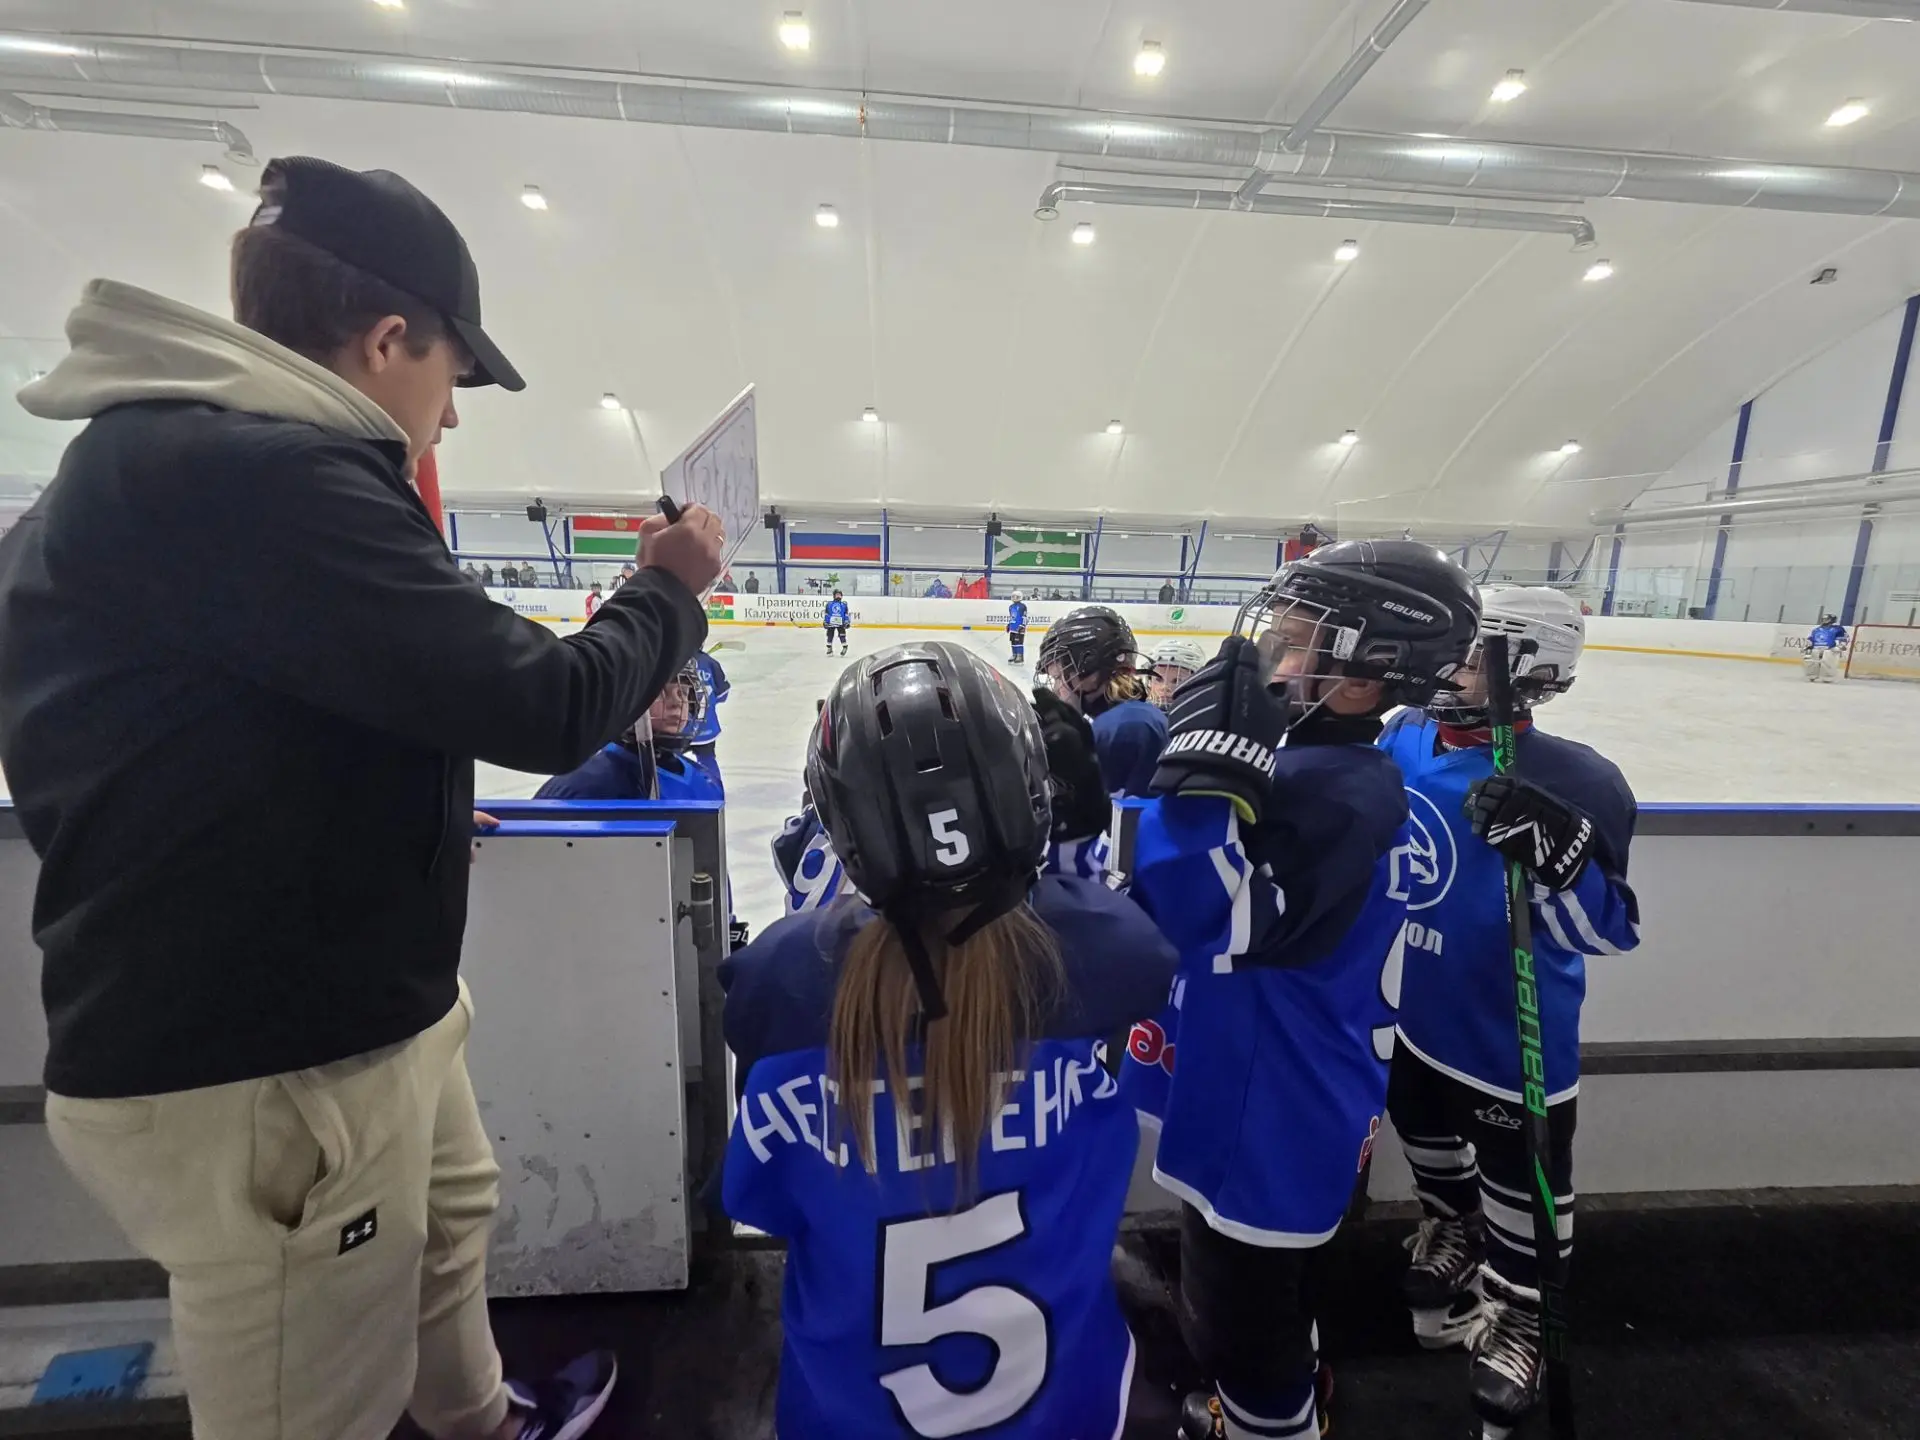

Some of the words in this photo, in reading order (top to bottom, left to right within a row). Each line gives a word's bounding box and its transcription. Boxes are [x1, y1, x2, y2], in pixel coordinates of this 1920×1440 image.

[744, 607, 811, 619] Калужской
[757, 596, 848, 609] Правительс
[1382, 601, 1434, 623] BAUER
[793, 832, 857, 911] 9
[928, 808, 970, 867] 5
[1514, 948, 1548, 1117] BAUER
[740, 1039, 1118, 1175] НЕСТЕЕНК
[878, 1190, 1048, 1439] 5
